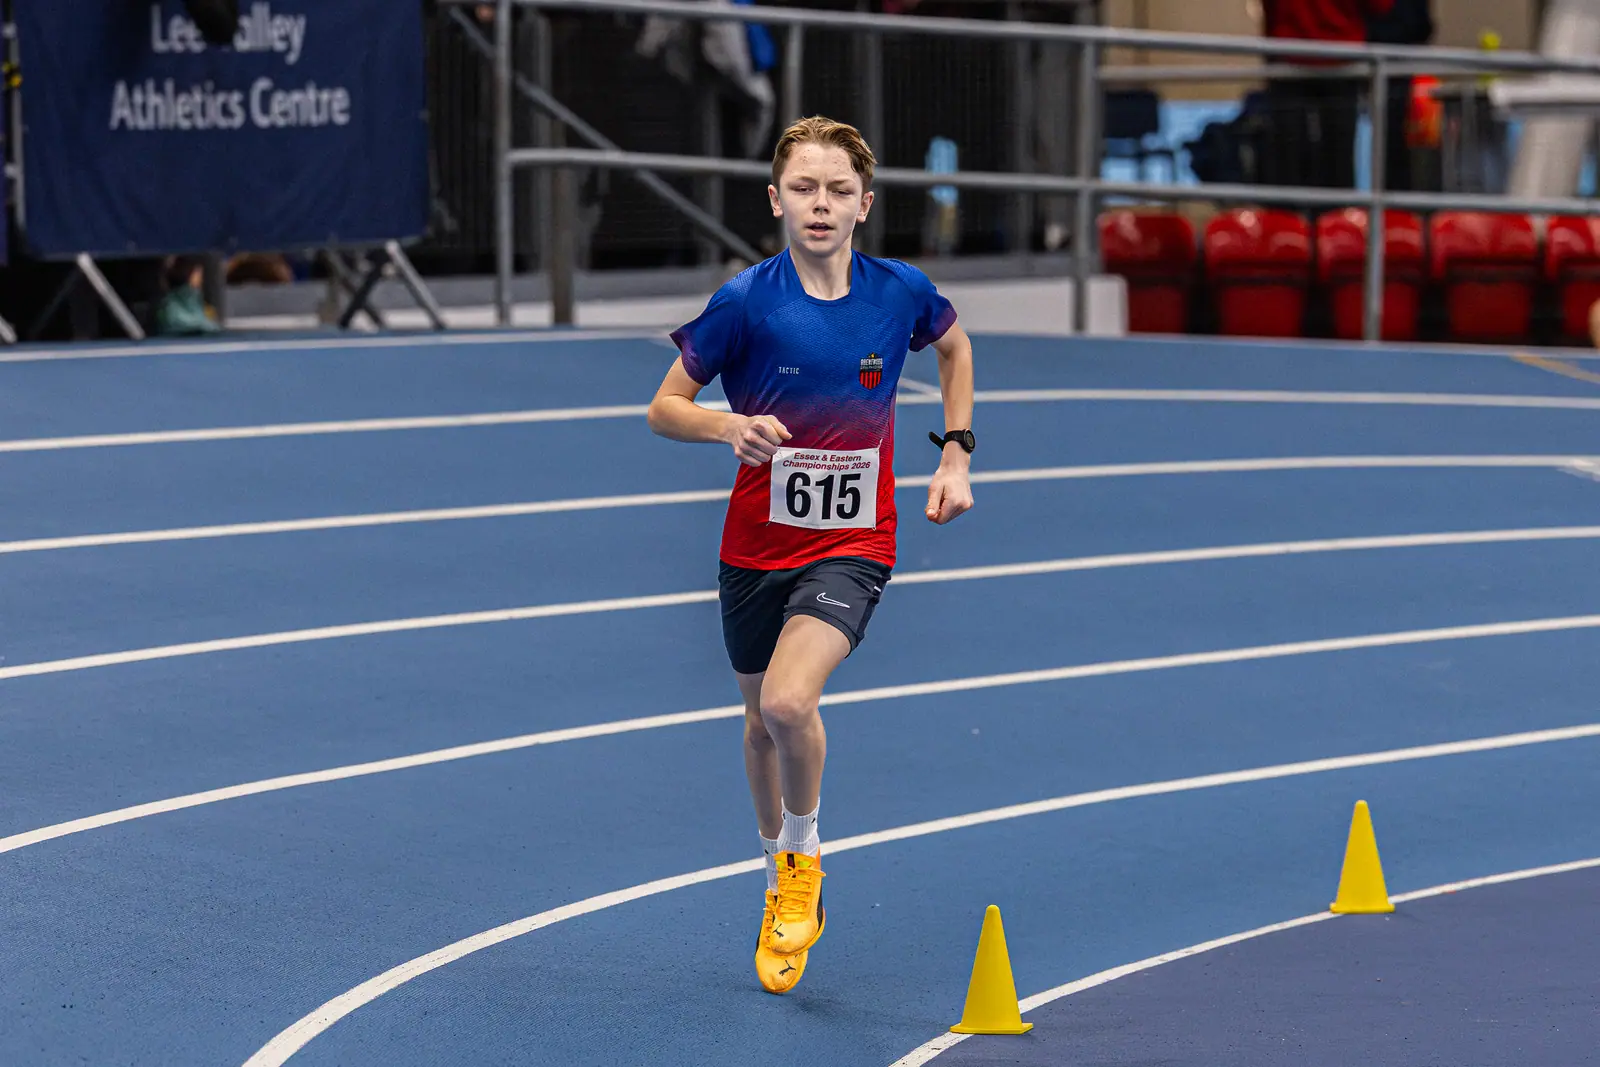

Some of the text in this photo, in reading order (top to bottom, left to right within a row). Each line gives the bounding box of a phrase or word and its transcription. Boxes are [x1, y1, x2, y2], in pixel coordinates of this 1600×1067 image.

[152, 1, 306, 65] Lee alley
[109, 77, 350, 130] Athletics Centre
[778, 366, 800, 375] TACTIC
[782, 460, 871, 471] Championships 2026
[793, 452, 819, 461] Essex
[829, 454, 862, 462] Eastern
[785, 471, 861, 520] 615
